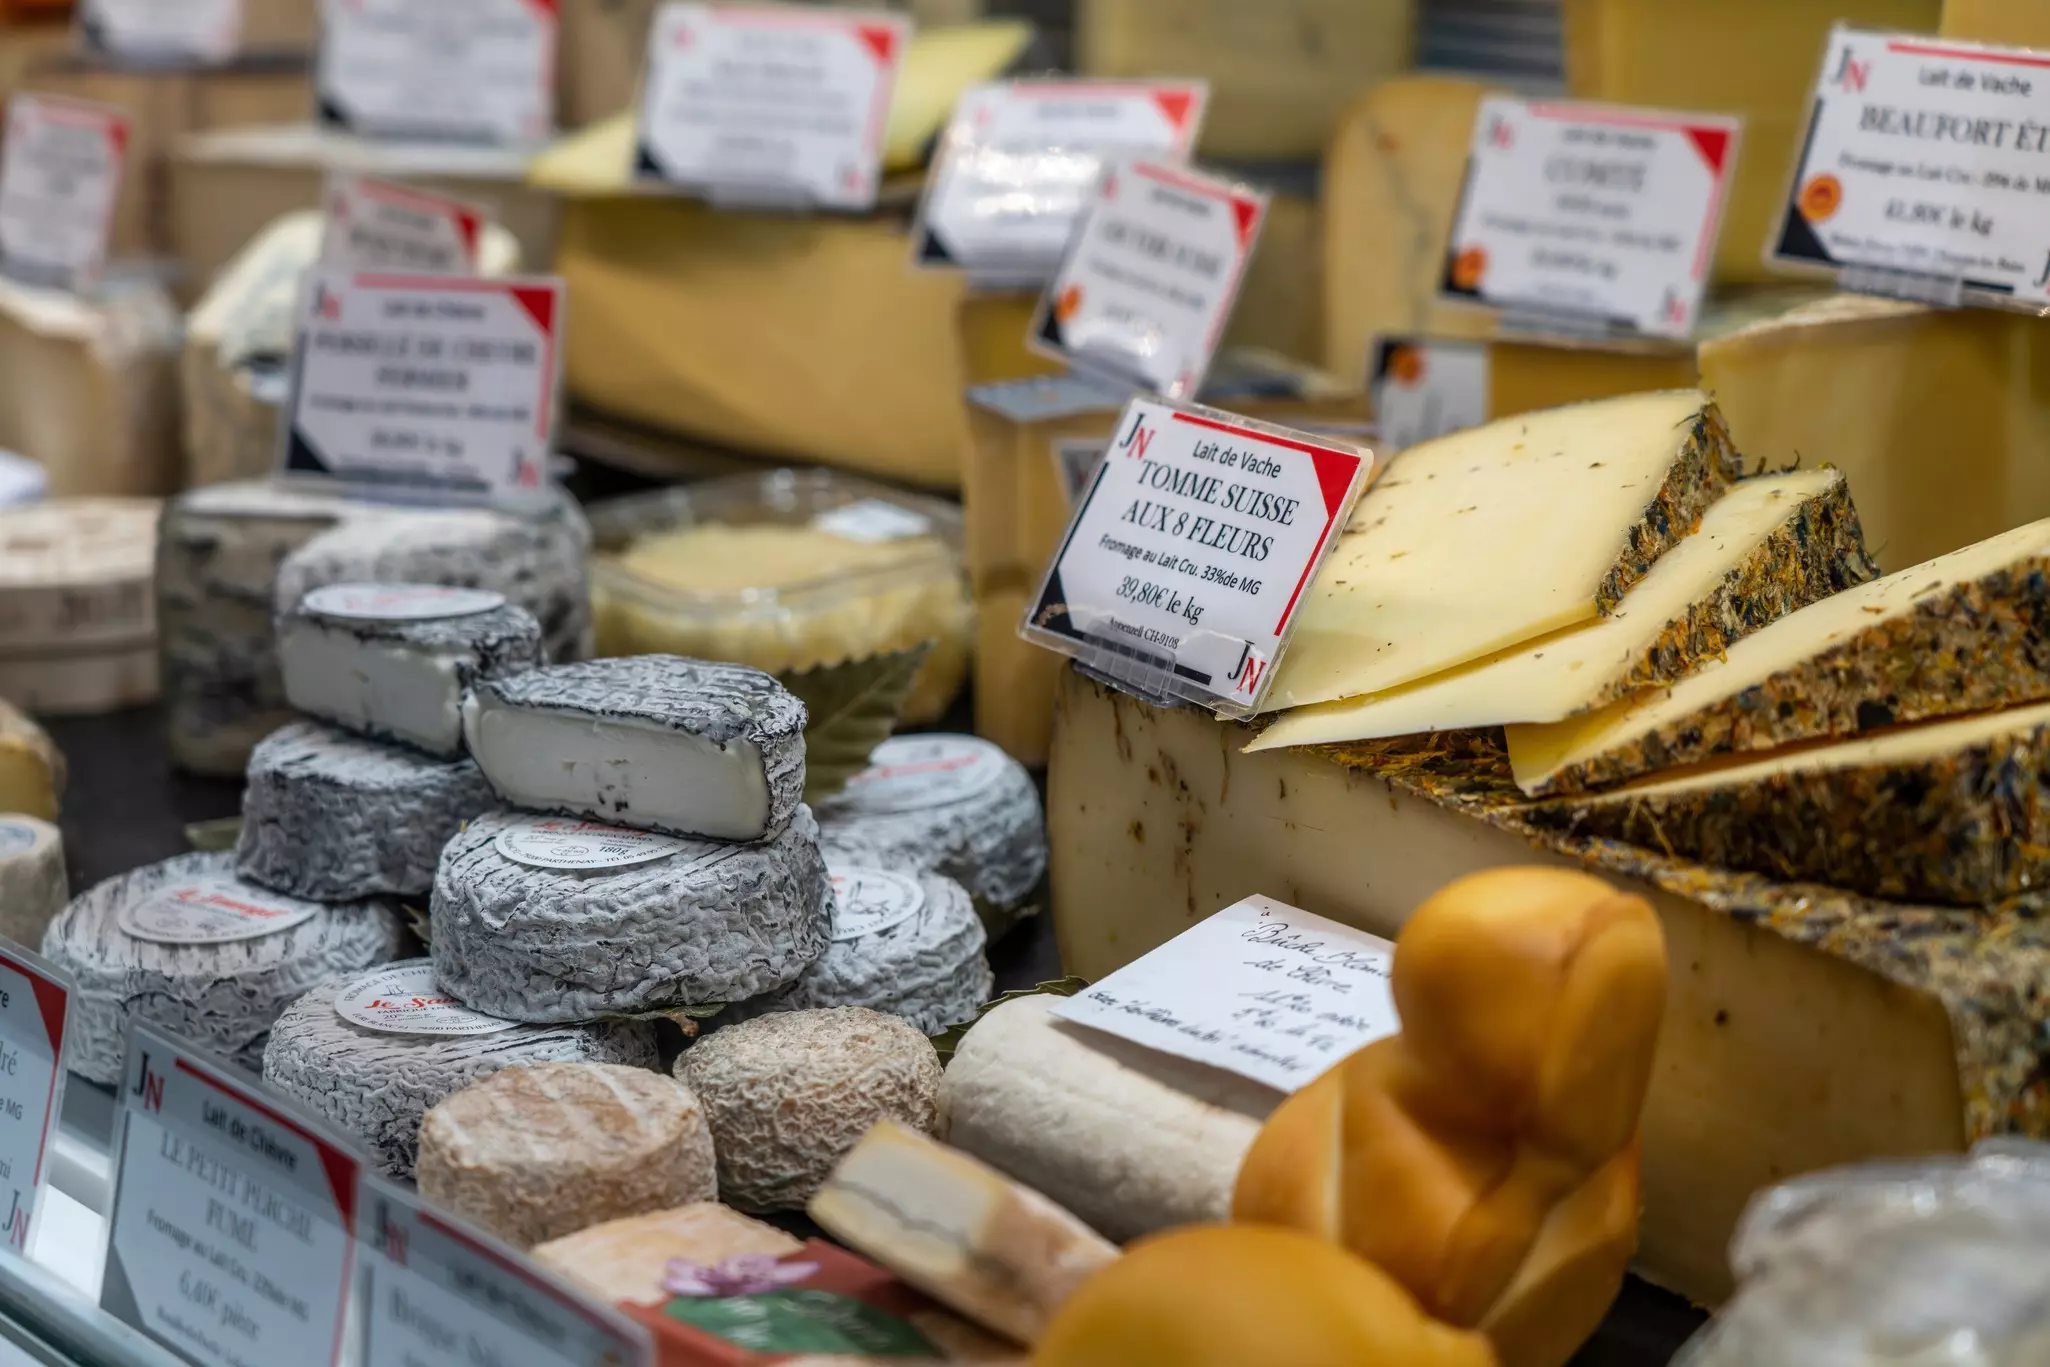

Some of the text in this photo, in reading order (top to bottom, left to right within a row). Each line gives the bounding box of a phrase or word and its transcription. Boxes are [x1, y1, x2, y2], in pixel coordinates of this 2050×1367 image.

[1830, 46, 1870, 94] JN
[1918, 65, 2032, 97] Lait de Vache
[1858, 104, 2050, 153] BEAUFORT ÉT
[1970, 208, 1994, 237] kg
[1119, 412, 1156, 461] JN
[1192, 440, 1282, 479] Lait de Vache
[1137, 459, 1301, 527] TOMME SUISSE
[1121, 499, 1275, 562] AUX 8 FLEURS
[1098, 533, 1143, 561] Fromage
[1142, 548, 1157, 564] au
[1157, 551, 1180, 571] Lait
[1178, 558, 1198, 577] Cru.
[1238, 576, 1262, 596] MG
[1115, 575, 1205, 626] 39,80€ le kg
[1144, 628, 1181, 650] CH-9108
[1227, 640, 1267, 695] JN
[598, 845, 629, 856] 180g
[133, 1051, 165, 1115] JN
[6, 1098, 24, 1121] MG
[203, 1099, 299, 1173] Lait de Chèvre
[160, 1131, 184, 1169] LE
[185, 1144, 240, 1199] PETIT
[2, 1188, 31, 1250] JN
[146, 1206, 193, 1249] Fromage
